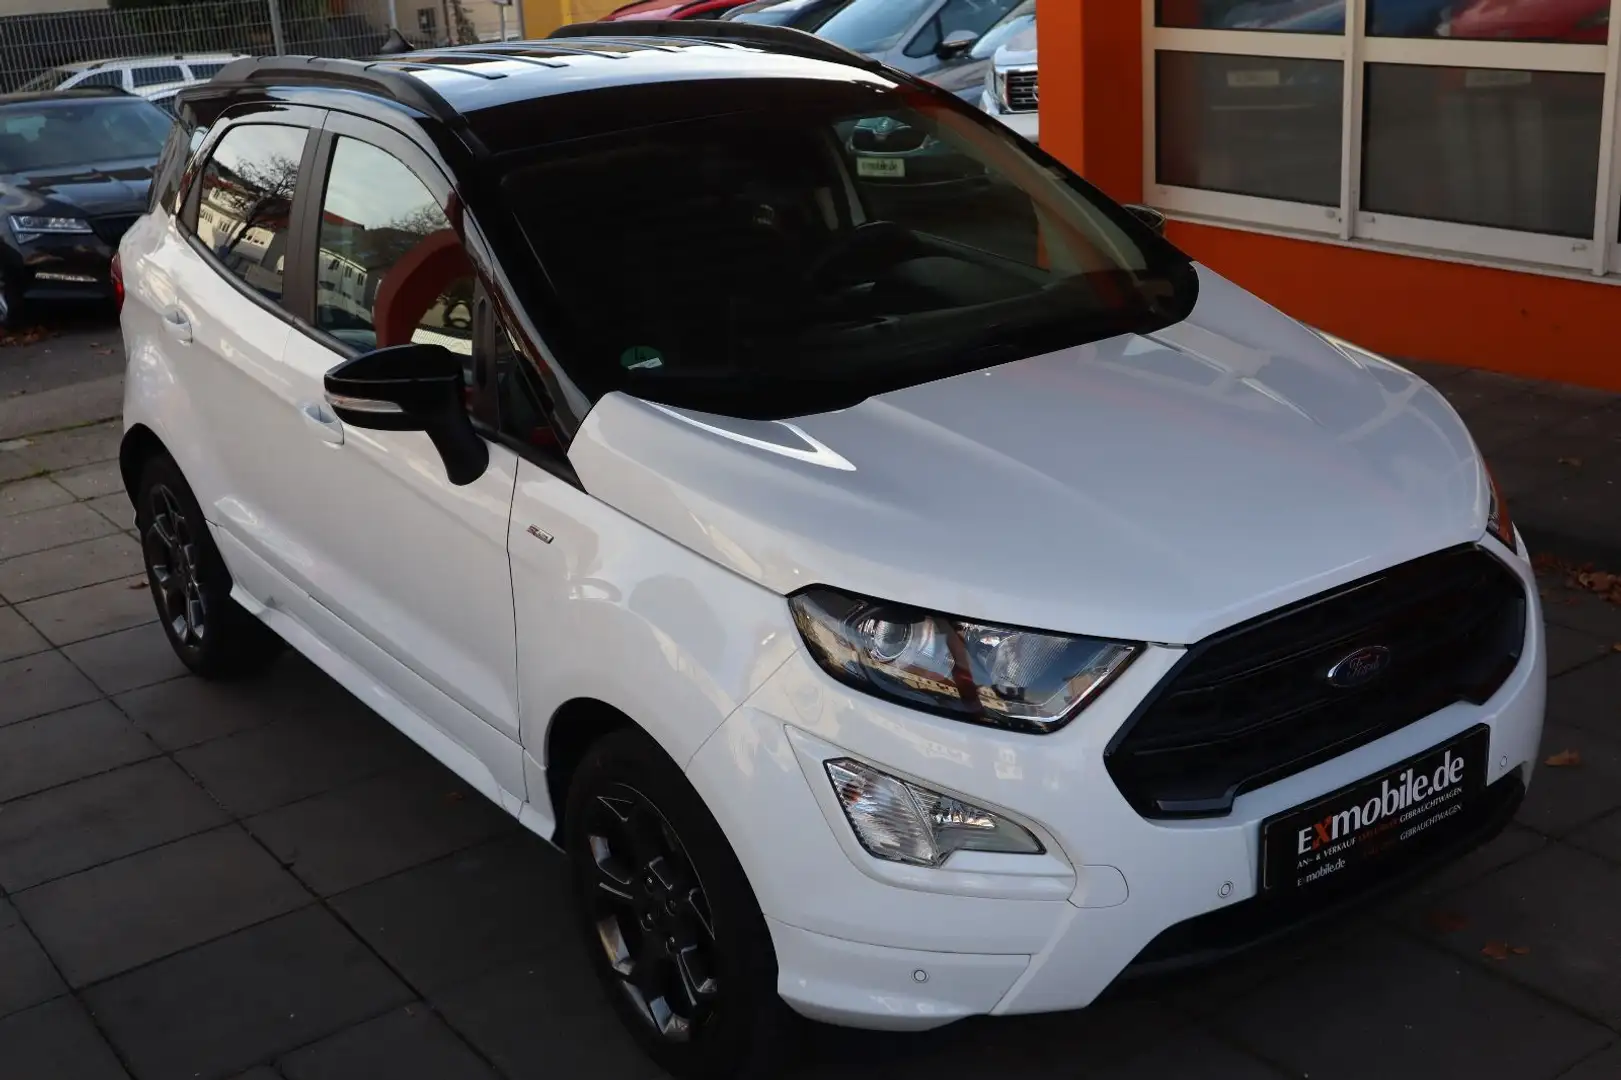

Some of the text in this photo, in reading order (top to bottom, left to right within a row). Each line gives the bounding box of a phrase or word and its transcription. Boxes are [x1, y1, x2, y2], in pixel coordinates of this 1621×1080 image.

[1346, 653, 1381, 677] Ford
[1297, 857, 1346, 887] Emobile.de
[1399, 803, 1463, 841] GEBRAUCHTWAGEN
[1315, 852, 1322, 861] &
[1323, 836, 1357, 859] VERKAUF
[1399, 787, 1463, 822] GEBRAUCHTWAGEN
